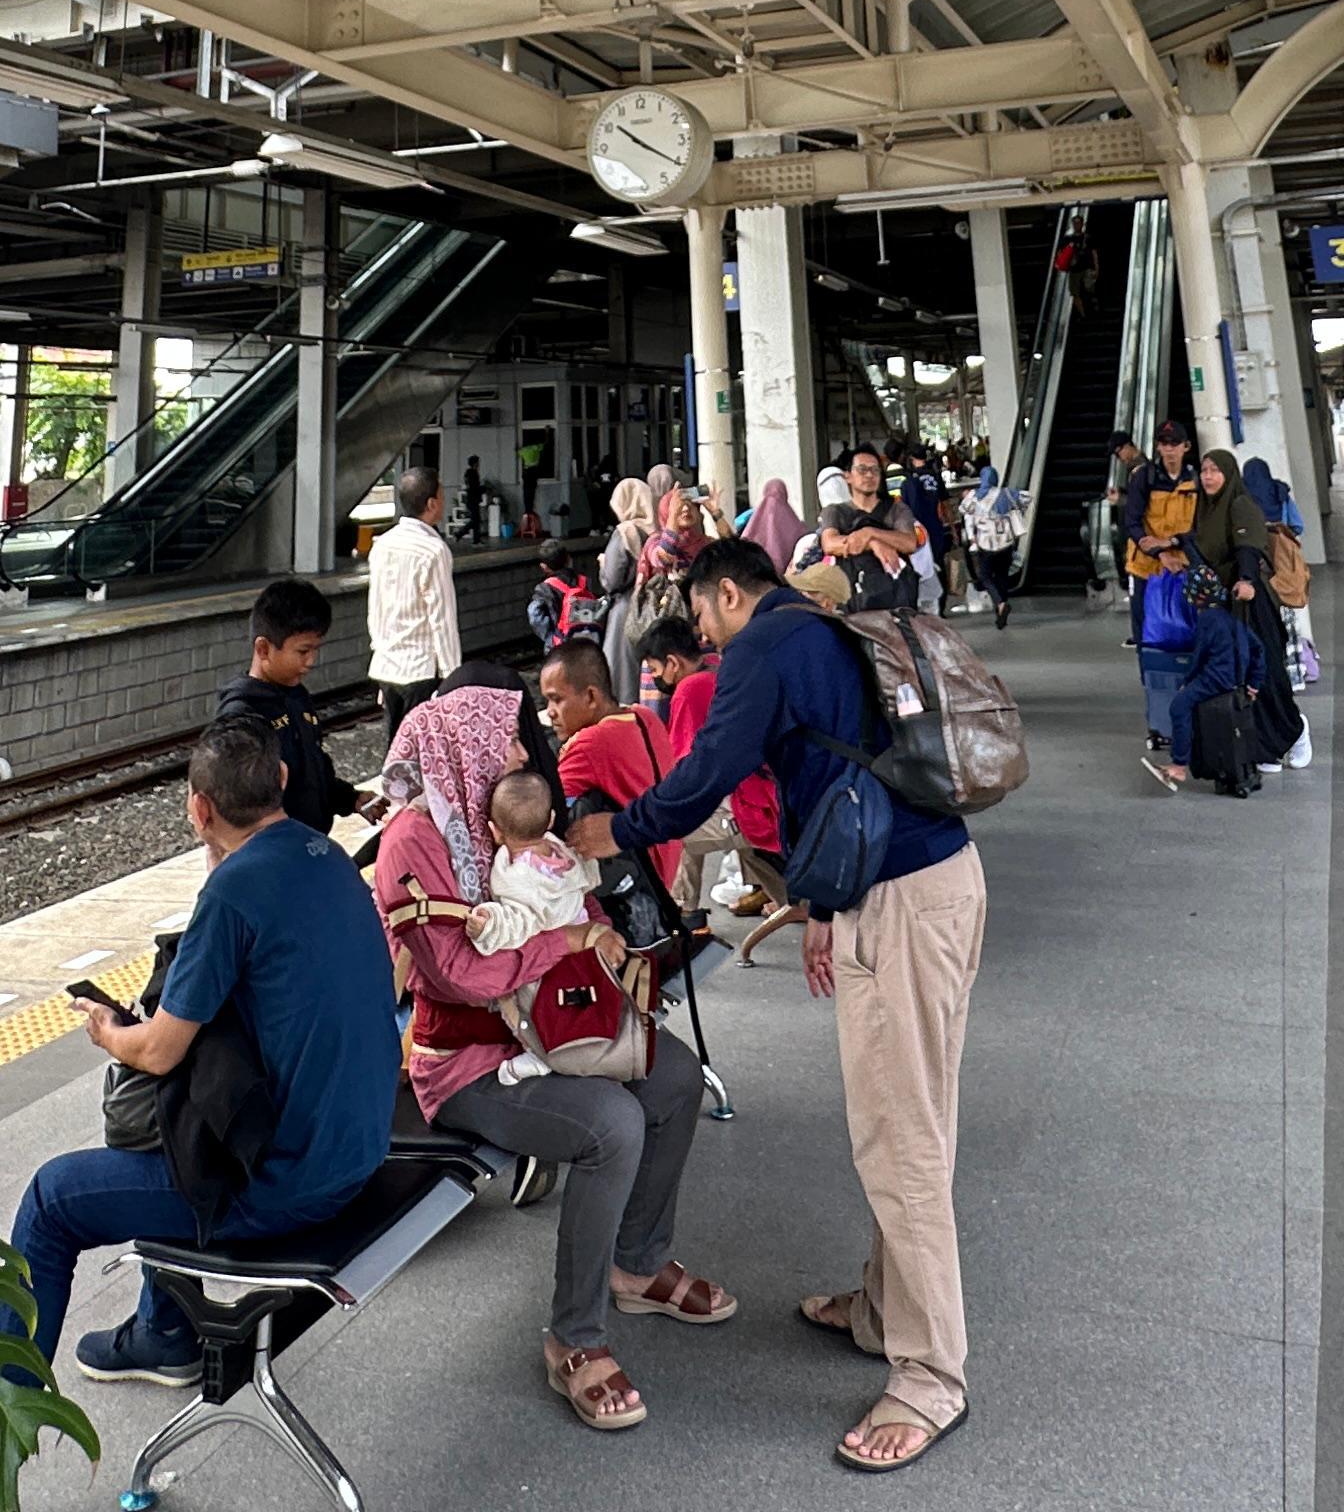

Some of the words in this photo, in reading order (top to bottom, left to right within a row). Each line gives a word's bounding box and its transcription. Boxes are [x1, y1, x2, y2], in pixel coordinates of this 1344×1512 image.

[635, 97, 646, 109] 12
[616, 103, 626, 116] 11
[671, 112, 679, 124] 2
[604, 122, 614, 133] 10
[678, 133, 686, 146] 3
[599, 143, 608, 154] 9
[659, 171, 669, 184] 5
